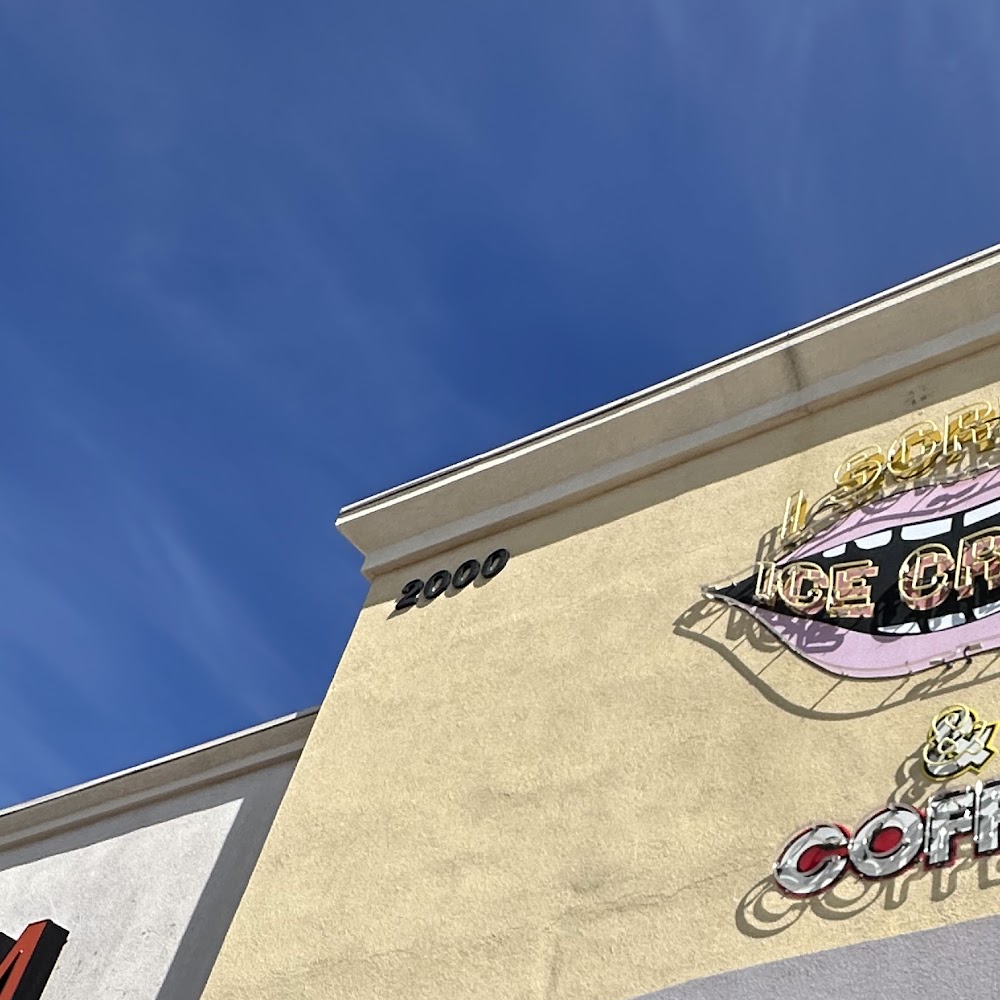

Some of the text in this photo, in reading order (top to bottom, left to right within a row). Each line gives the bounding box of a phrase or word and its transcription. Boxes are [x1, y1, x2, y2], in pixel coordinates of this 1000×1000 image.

[777, 490, 808, 547] I
[395, 548, 511, 611] 2000
[754, 559, 879, 620] ICE
